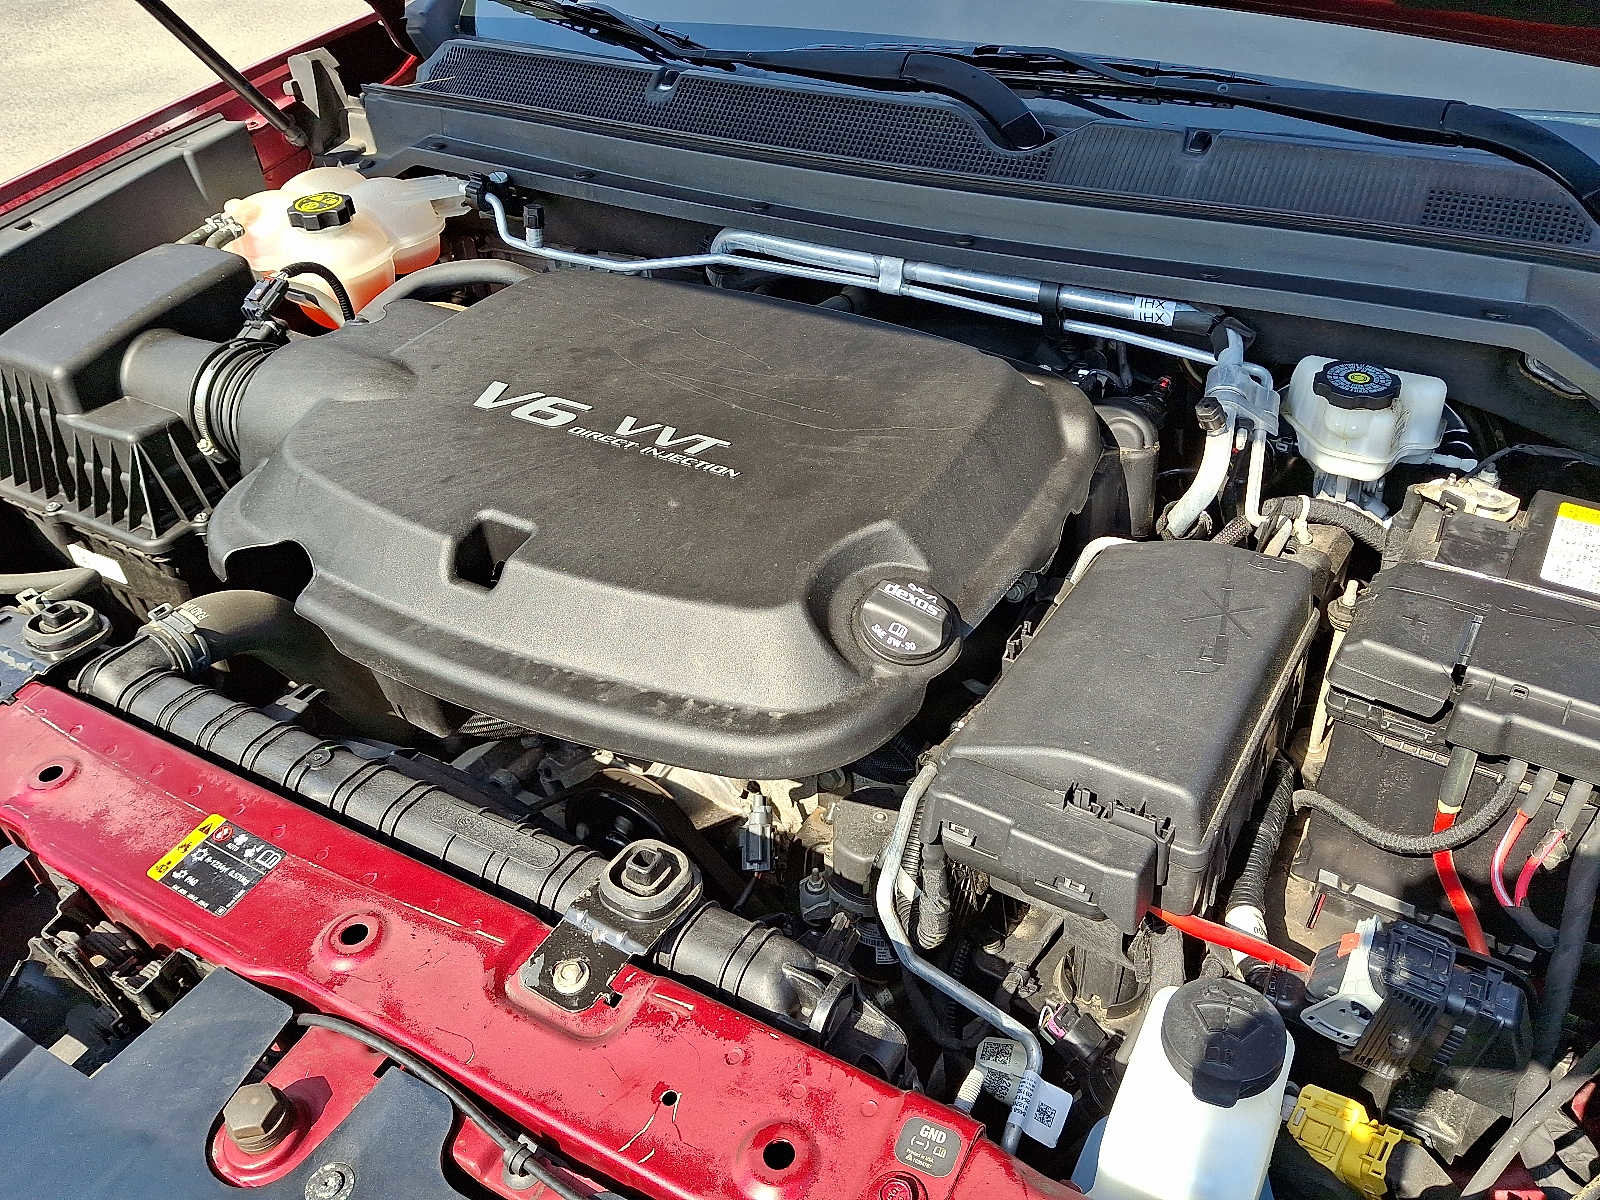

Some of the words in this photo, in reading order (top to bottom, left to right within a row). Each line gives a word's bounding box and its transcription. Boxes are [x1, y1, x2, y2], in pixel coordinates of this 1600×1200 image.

[1139, 311, 1165, 323] IHX
[1140, 297, 1167, 310] IHX
[473, 380, 593, 428] V6
[615, 415, 732, 455] VVT
[567, 426, 639, 449] DIRECT
[640, 446, 741, 479] INJECTION
[884, 583, 941, 617] dexos
[919, 1124, 947, 1144] GND
